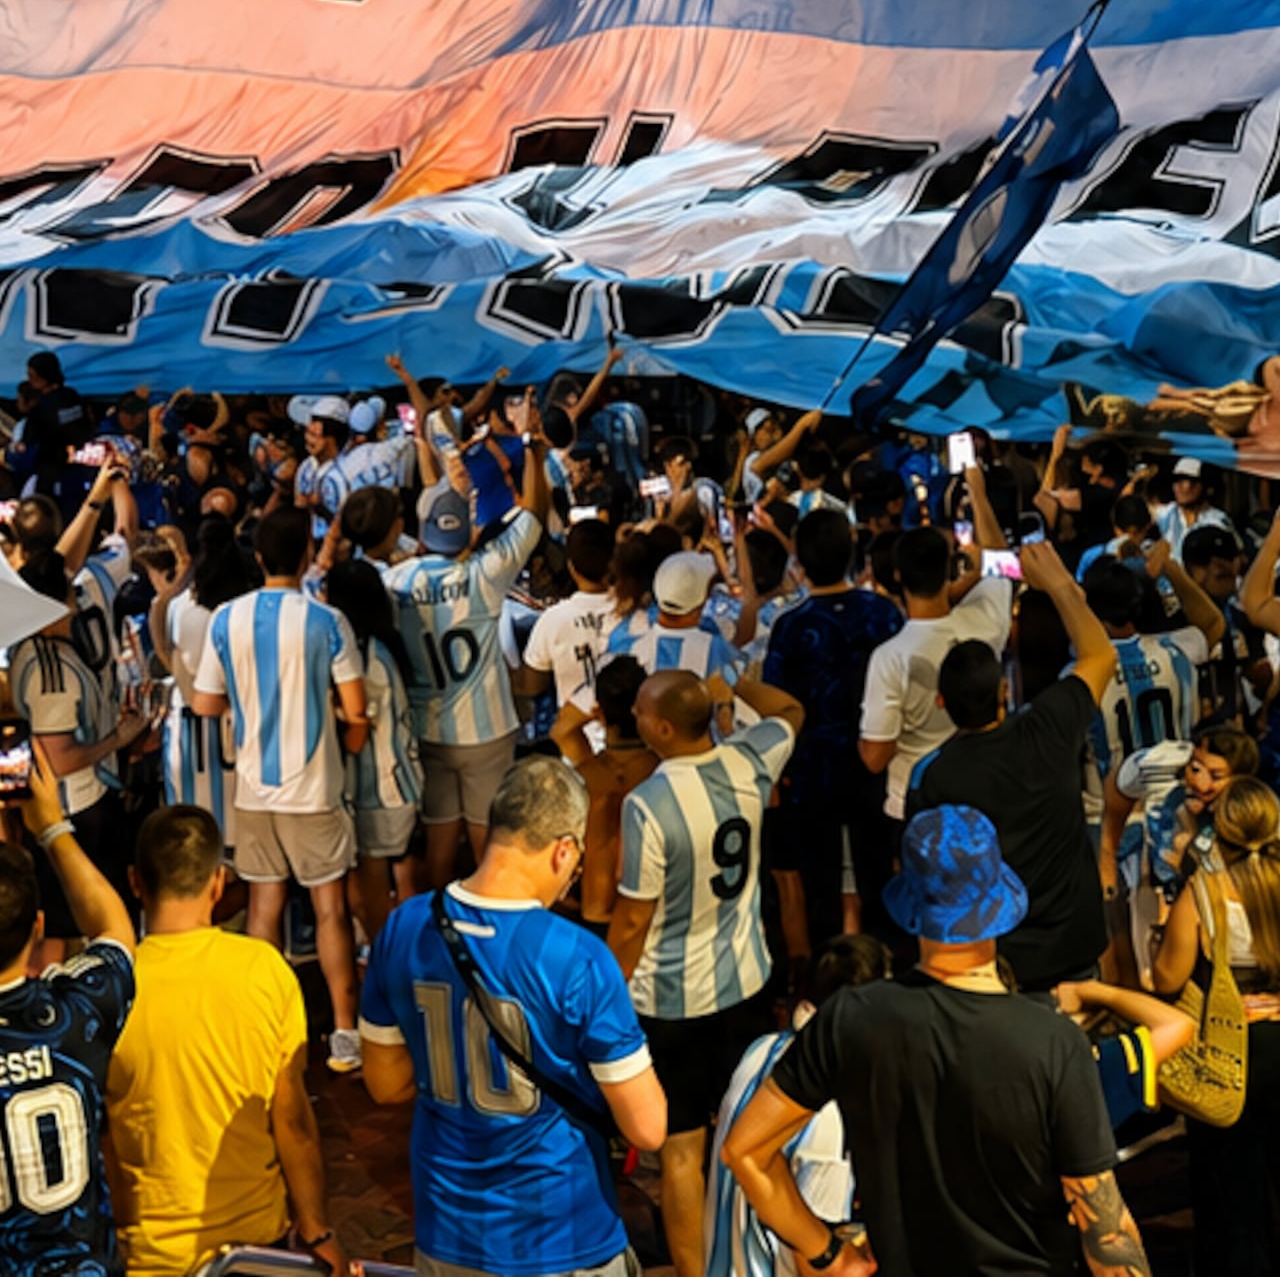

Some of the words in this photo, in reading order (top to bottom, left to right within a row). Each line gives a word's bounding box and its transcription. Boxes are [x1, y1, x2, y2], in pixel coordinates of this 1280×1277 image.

[422, 627, 481, 691] 10
[709, 818, 752, 900] 9
[414, 981, 541, 1117] 10
